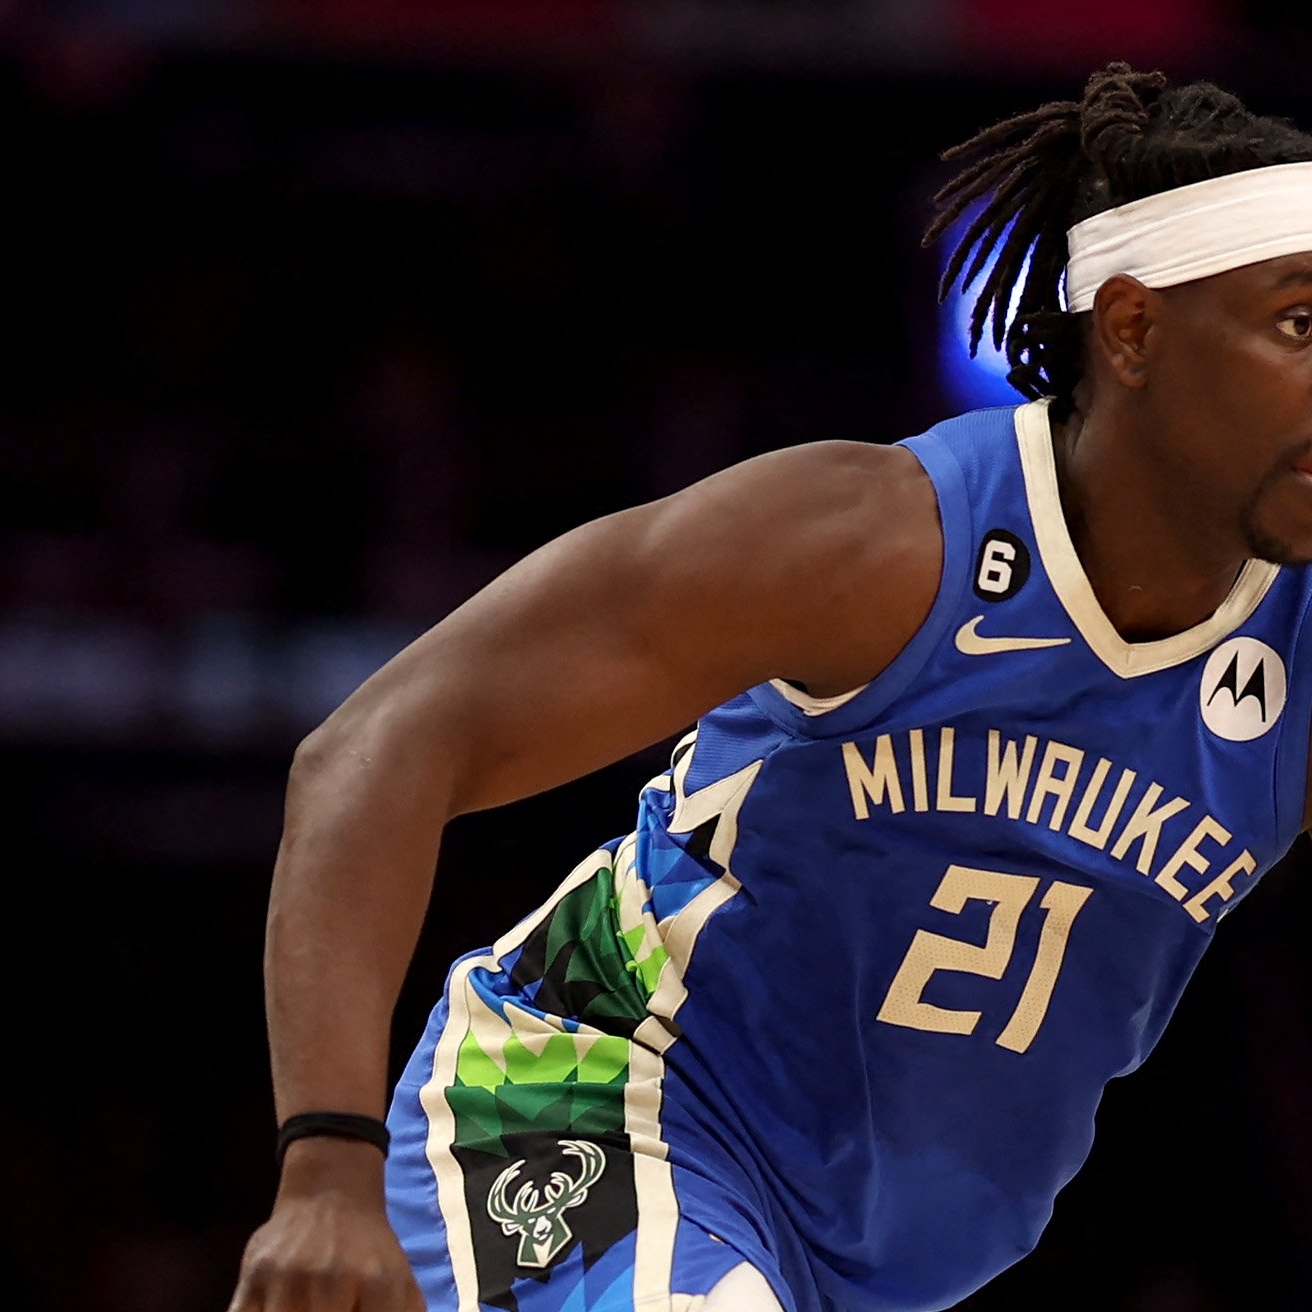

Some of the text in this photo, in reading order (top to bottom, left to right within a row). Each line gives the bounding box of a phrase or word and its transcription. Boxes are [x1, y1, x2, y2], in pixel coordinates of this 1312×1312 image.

[978, 540, 1016, 593] 6
[841, 727, 1257, 924] MILWAUKEE
[876, 864, 1094, 1055] 21
